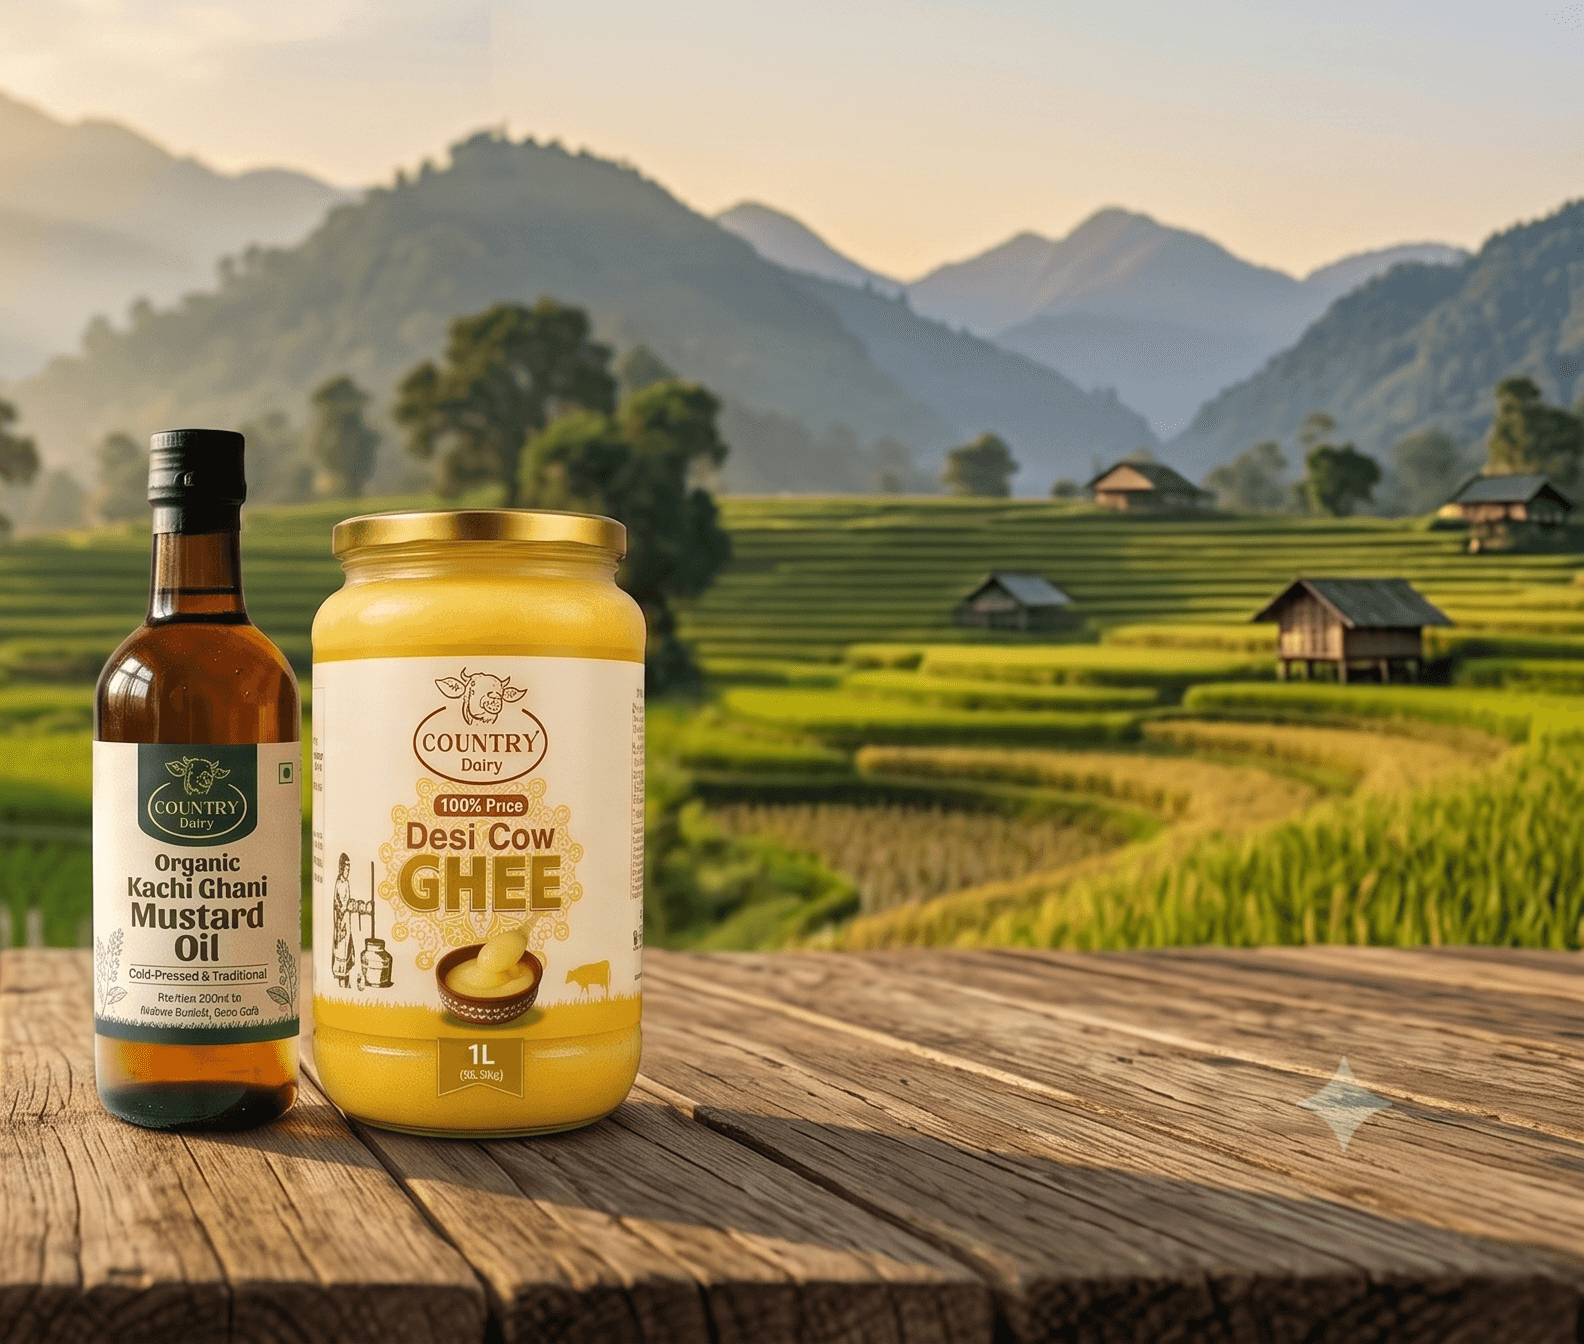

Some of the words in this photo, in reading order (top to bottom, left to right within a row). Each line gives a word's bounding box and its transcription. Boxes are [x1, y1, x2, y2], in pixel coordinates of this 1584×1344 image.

[422, 730, 540, 754] COUNTRY
[461, 758, 503, 776] Dairy
[154, 800, 239, 815] COUNTRY
[440, 797, 482, 813] 100%
[179, 817, 215, 831] Dairy
[406, 821, 476, 851] Desi
[488, 822, 556, 851] Cow
[154, 853, 241, 877] Organic
[127, 876, 193, 899] Kachi
[198, 875, 268, 899] Ghani
[397, 853, 564, 913] GHEE
[130, 901, 264, 930] Mustard
[174, 933, 220, 962] Oil
[128, 968, 199, 981] Cold-Pressed
[201, 971, 210, 981] &
[212, 968, 267, 981] Traditional
[468, 1044, 495, 1065] 1L
